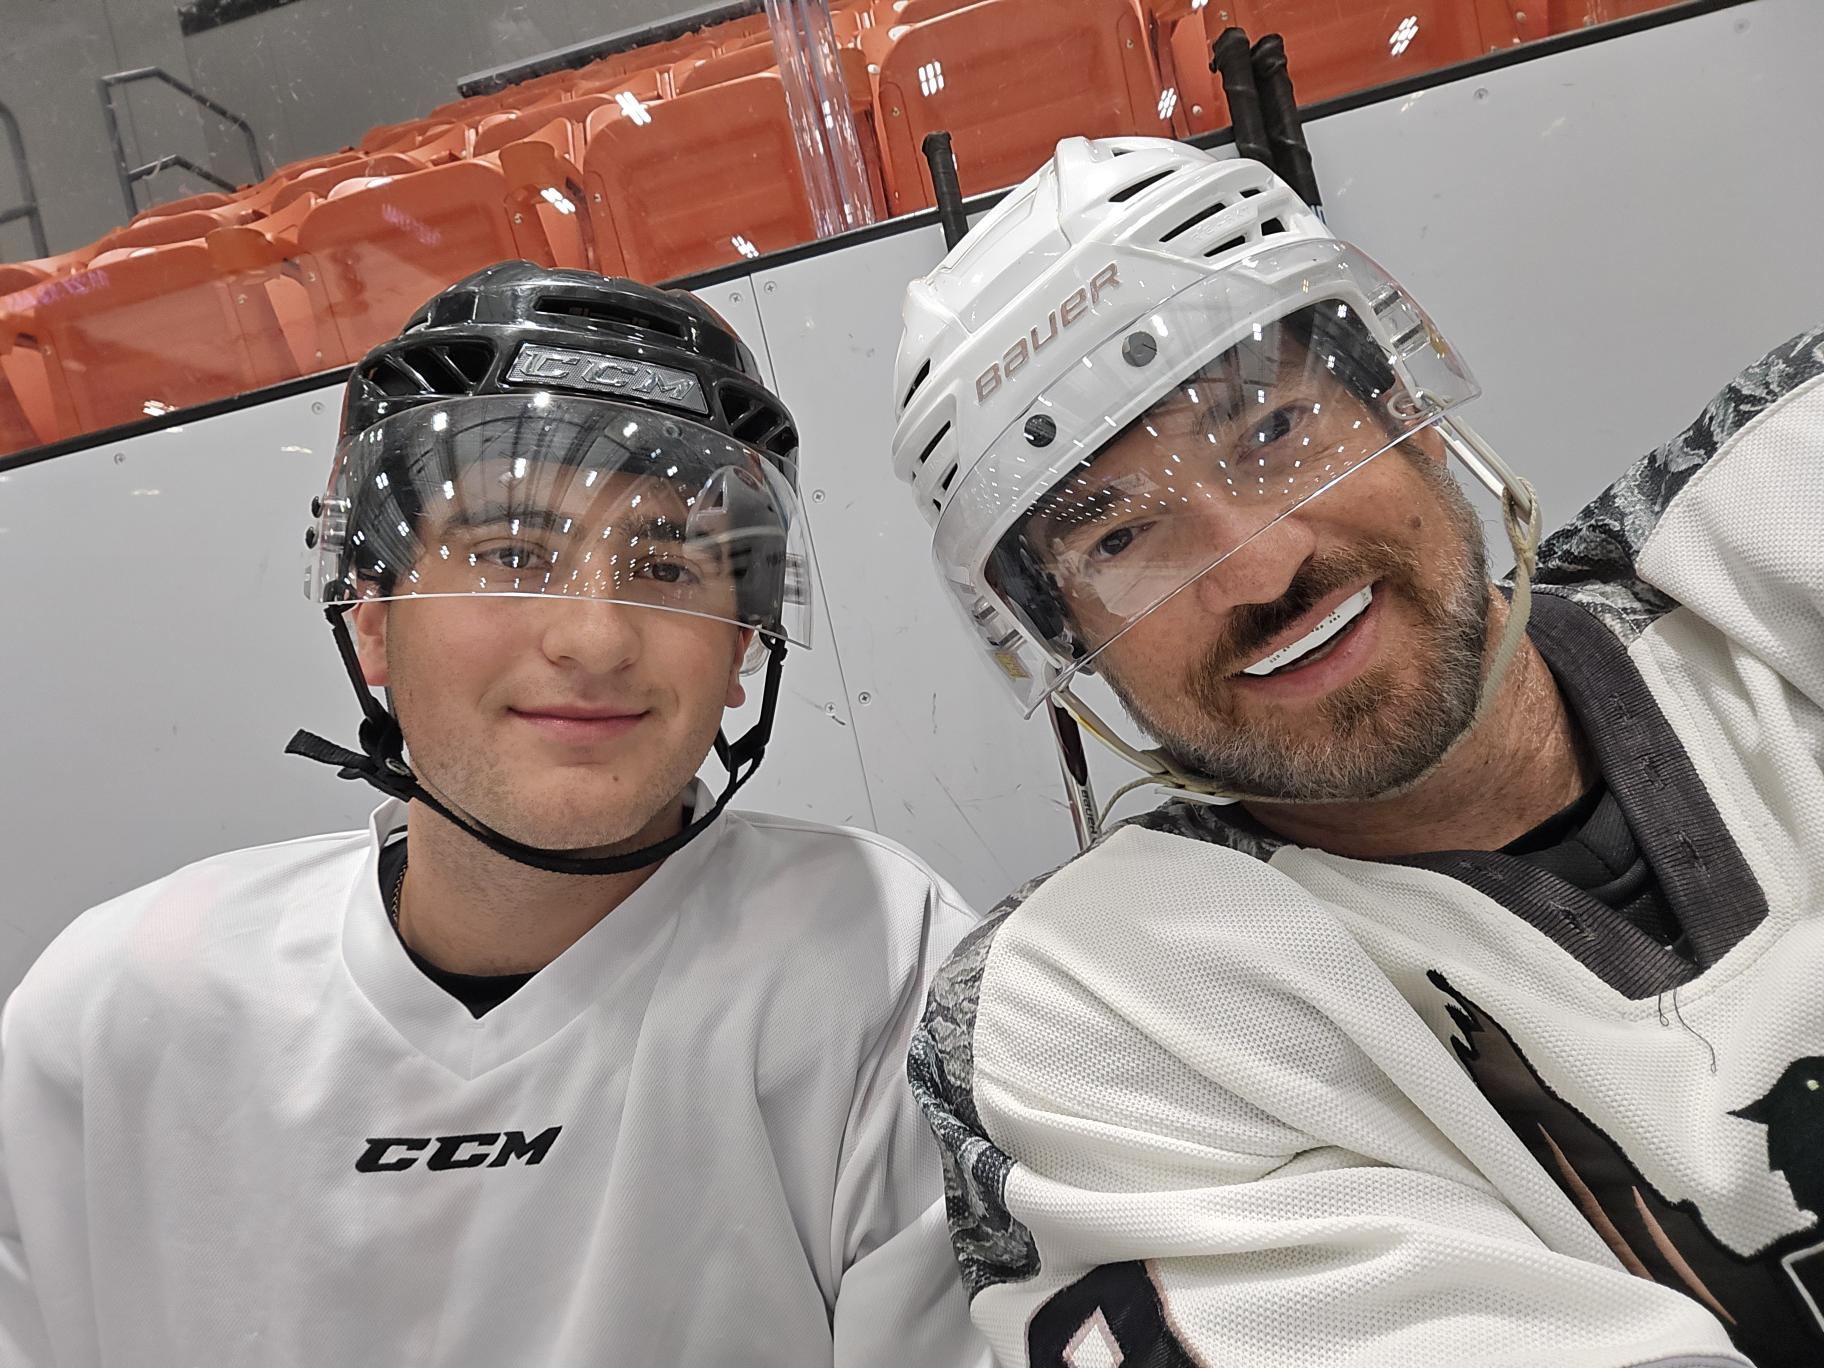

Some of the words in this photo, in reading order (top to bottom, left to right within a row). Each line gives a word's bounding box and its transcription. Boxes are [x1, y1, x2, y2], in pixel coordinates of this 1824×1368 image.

[975, 261, 1120, 402] BAUER
[519, 350, 695, 400] CCM
[355, 1125, 563, 1173] CCM
